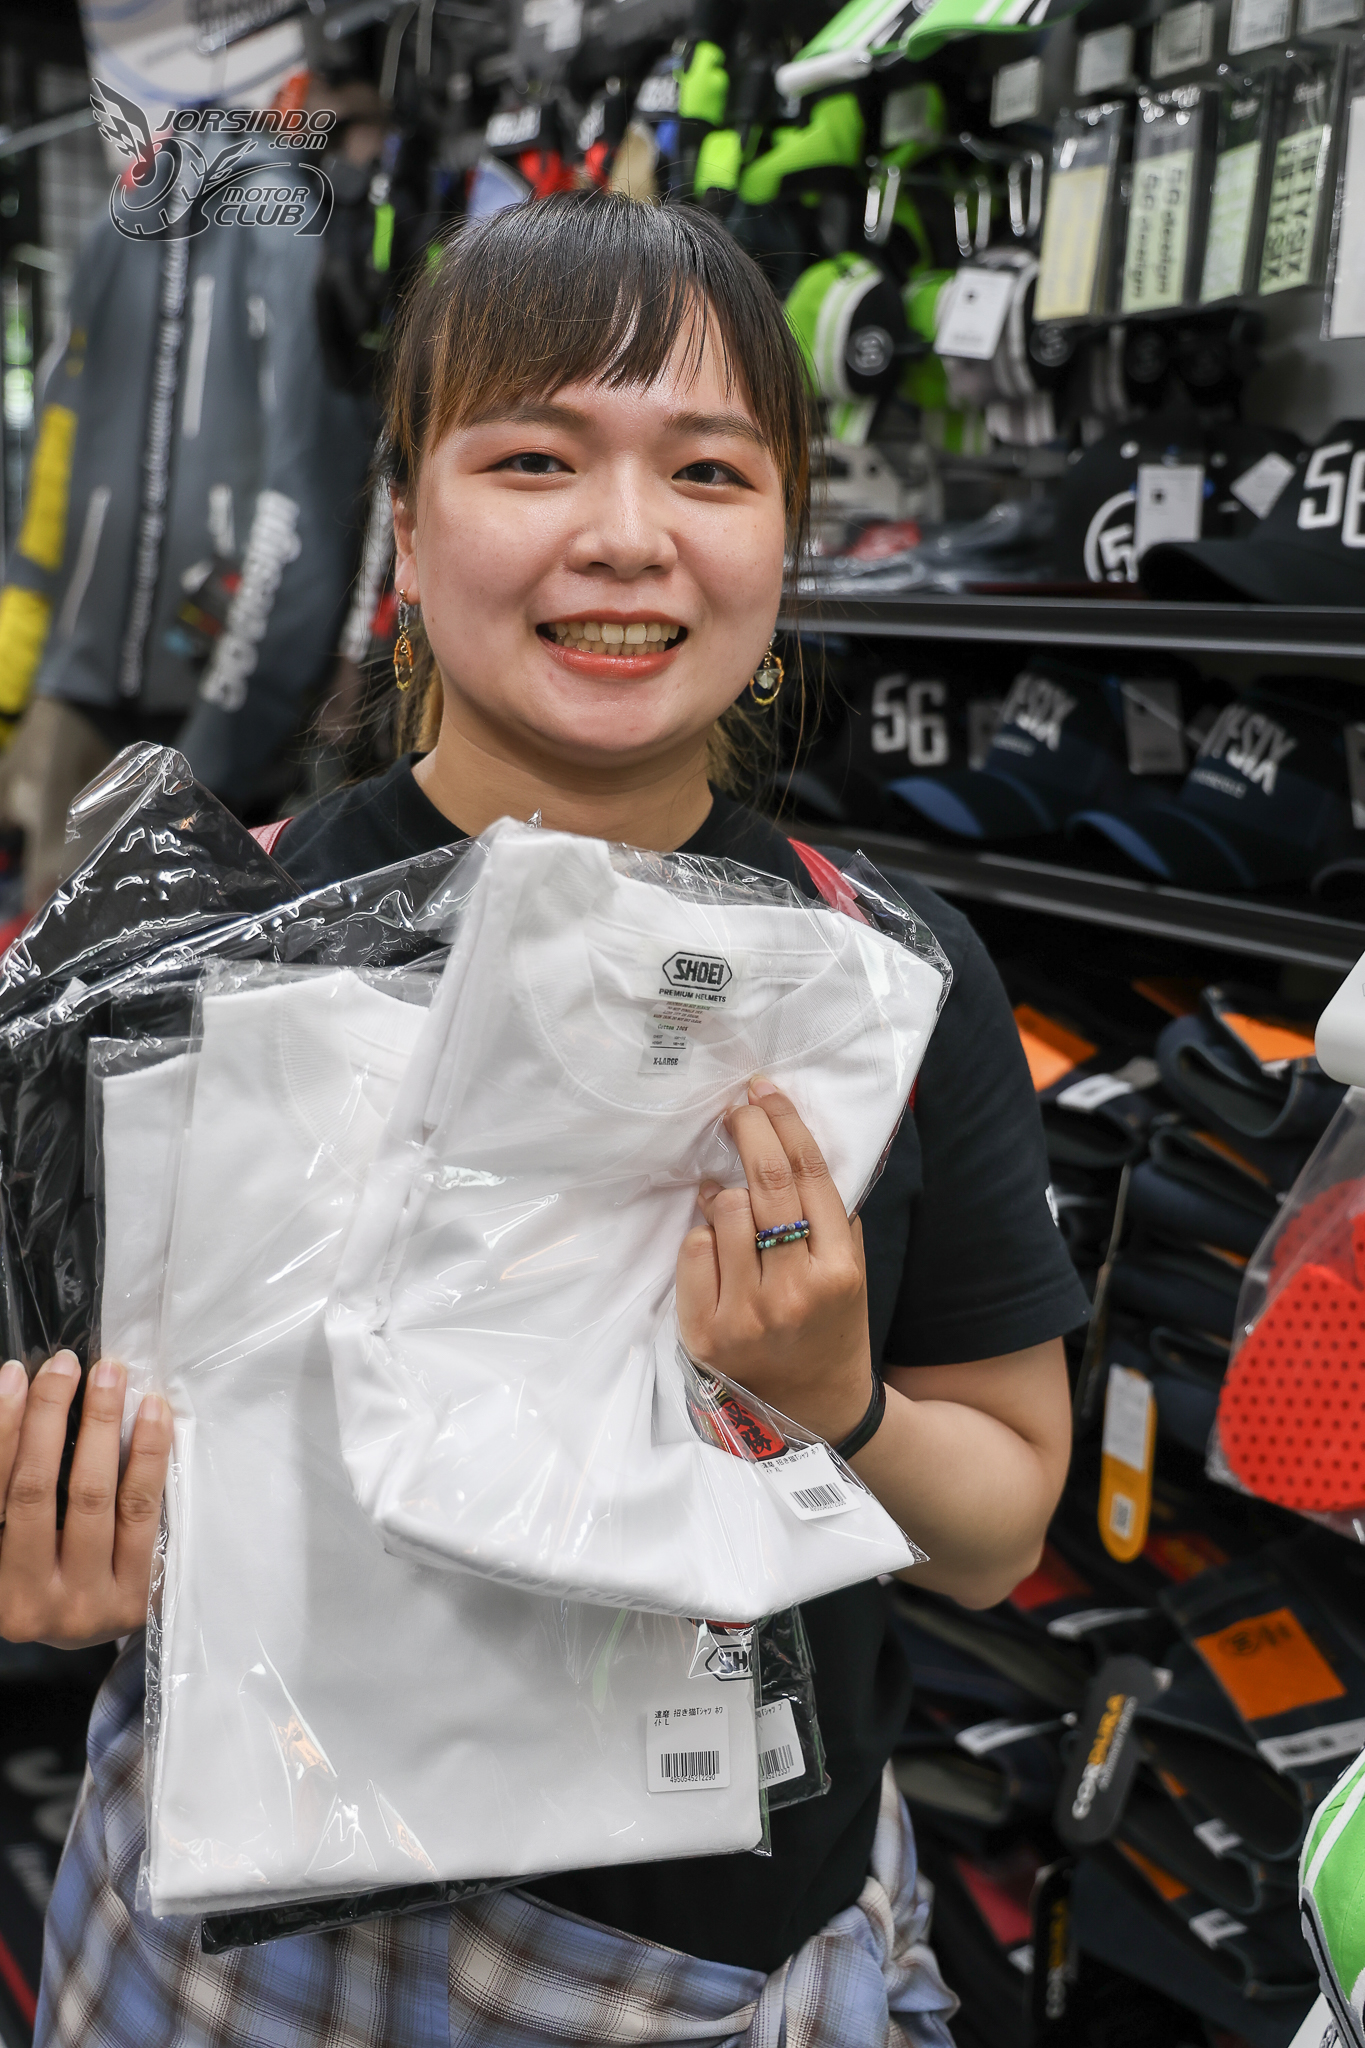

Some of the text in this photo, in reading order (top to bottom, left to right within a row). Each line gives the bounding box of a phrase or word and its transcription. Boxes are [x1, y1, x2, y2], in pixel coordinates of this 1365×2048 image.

[673, 959, 724, 985] SHOEI
[659, 988, 726, 1003] PREMIUM HELMETS
[653, 1057, 678, 1065] X-LARGE
[719, 1651, 752, 1673] SH
[670, 1774, 715, 1783] 4950545212290
